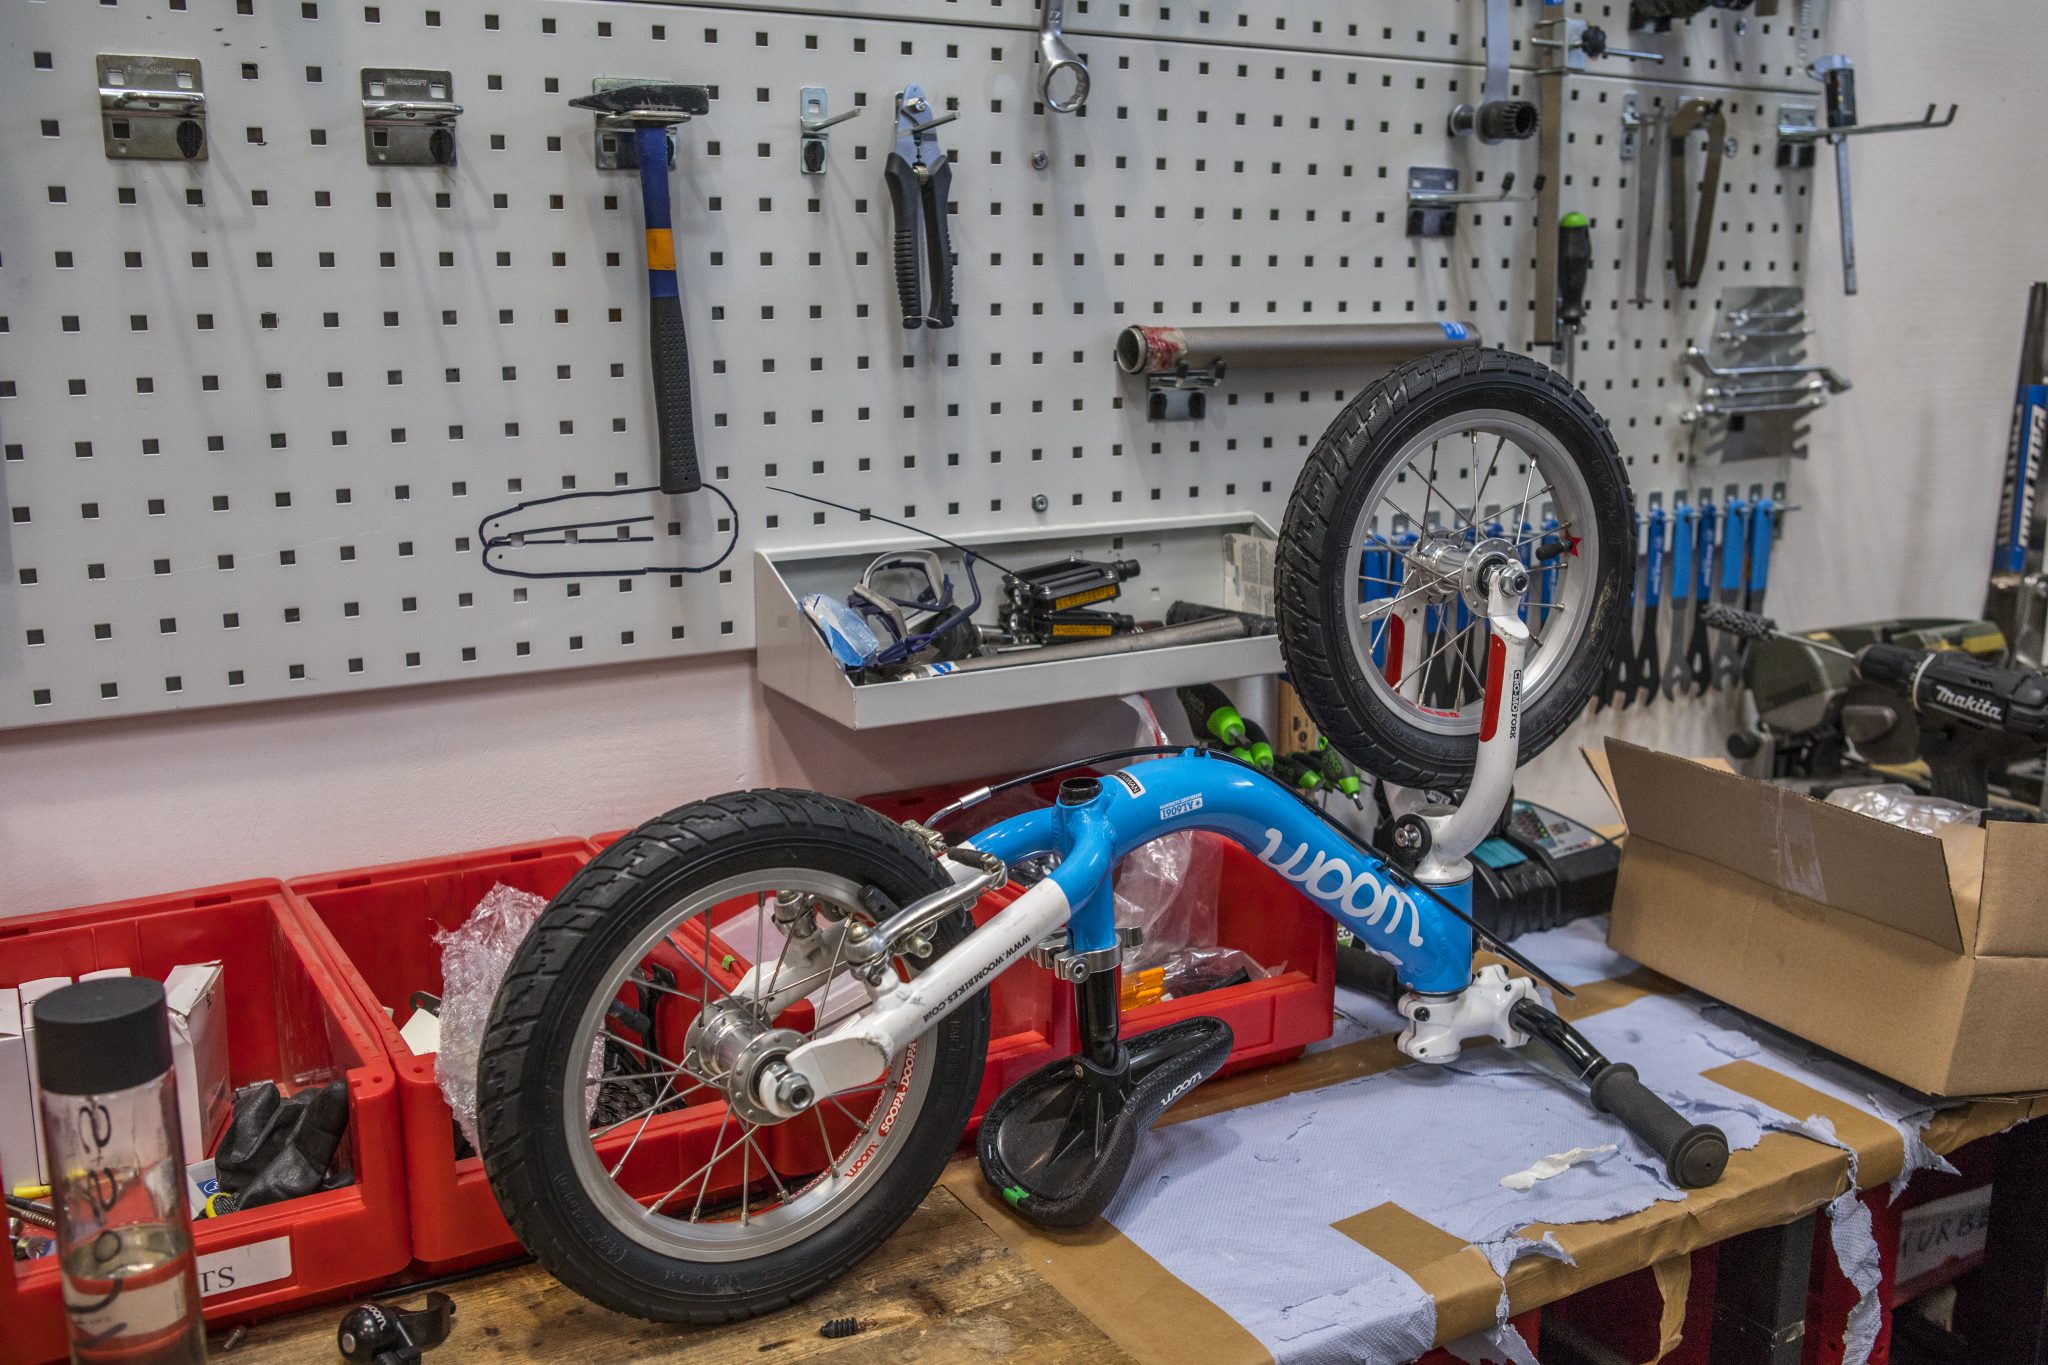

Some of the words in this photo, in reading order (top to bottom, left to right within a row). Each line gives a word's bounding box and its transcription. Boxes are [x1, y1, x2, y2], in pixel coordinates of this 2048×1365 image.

[1511, 670, 1521, 712] CRO-MO
[1510, 713, 1518, 739] FORK
[1161, 799, 1194, 819] AL6061
[1257, 828, 1423, 947] woom
[923, 935, 1031, 1023] WWW.WOOMBIKES.COM
[1160, 1071, 1203, 1106] woom
[845, 1142, 879, 1179] woom
[360, 1303, 388, 1331] woom
